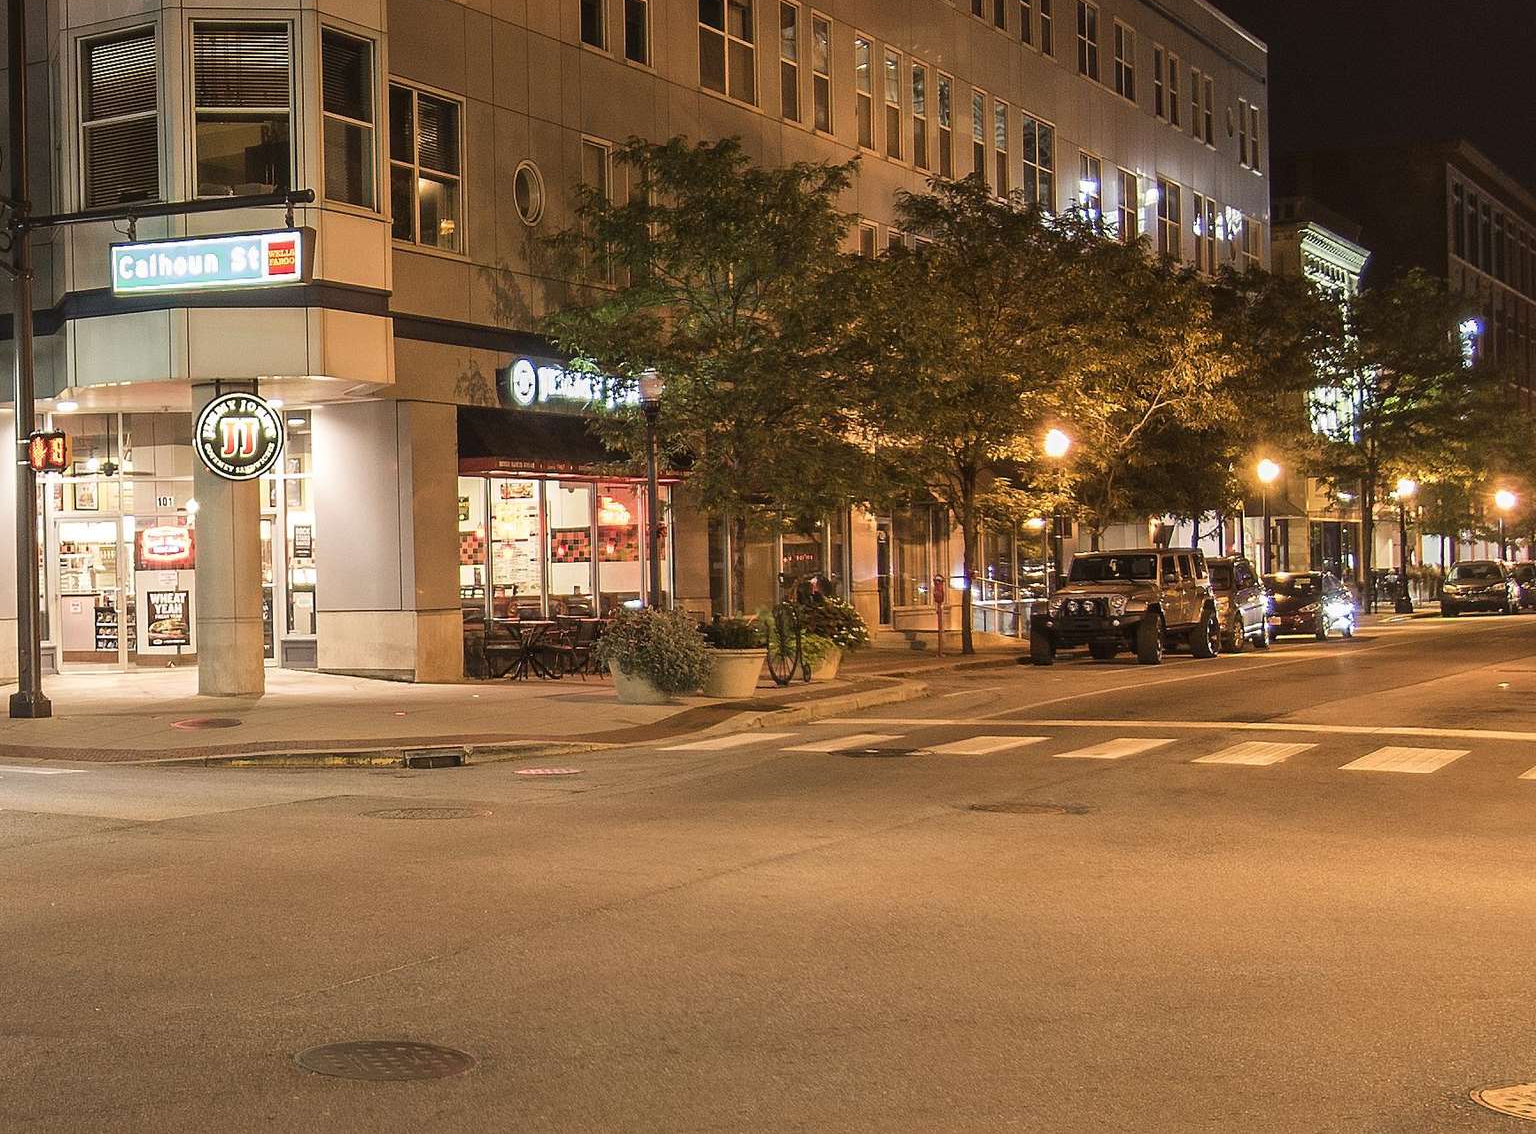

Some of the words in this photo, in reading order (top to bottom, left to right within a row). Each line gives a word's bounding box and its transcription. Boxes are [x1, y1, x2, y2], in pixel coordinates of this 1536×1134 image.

[268, 248, 295, 258] WELLS
[119, 253, 218, 280] Calhoun
[230, 245, 260, 271] St
[268, 257, 295, 266] FARGO
[220, 417, 260, 458] JJ
[158, 496, 172, 506] 101
[150, 592, 186, 604] WHEAT
[154, 603, 183, 614] YEAH
